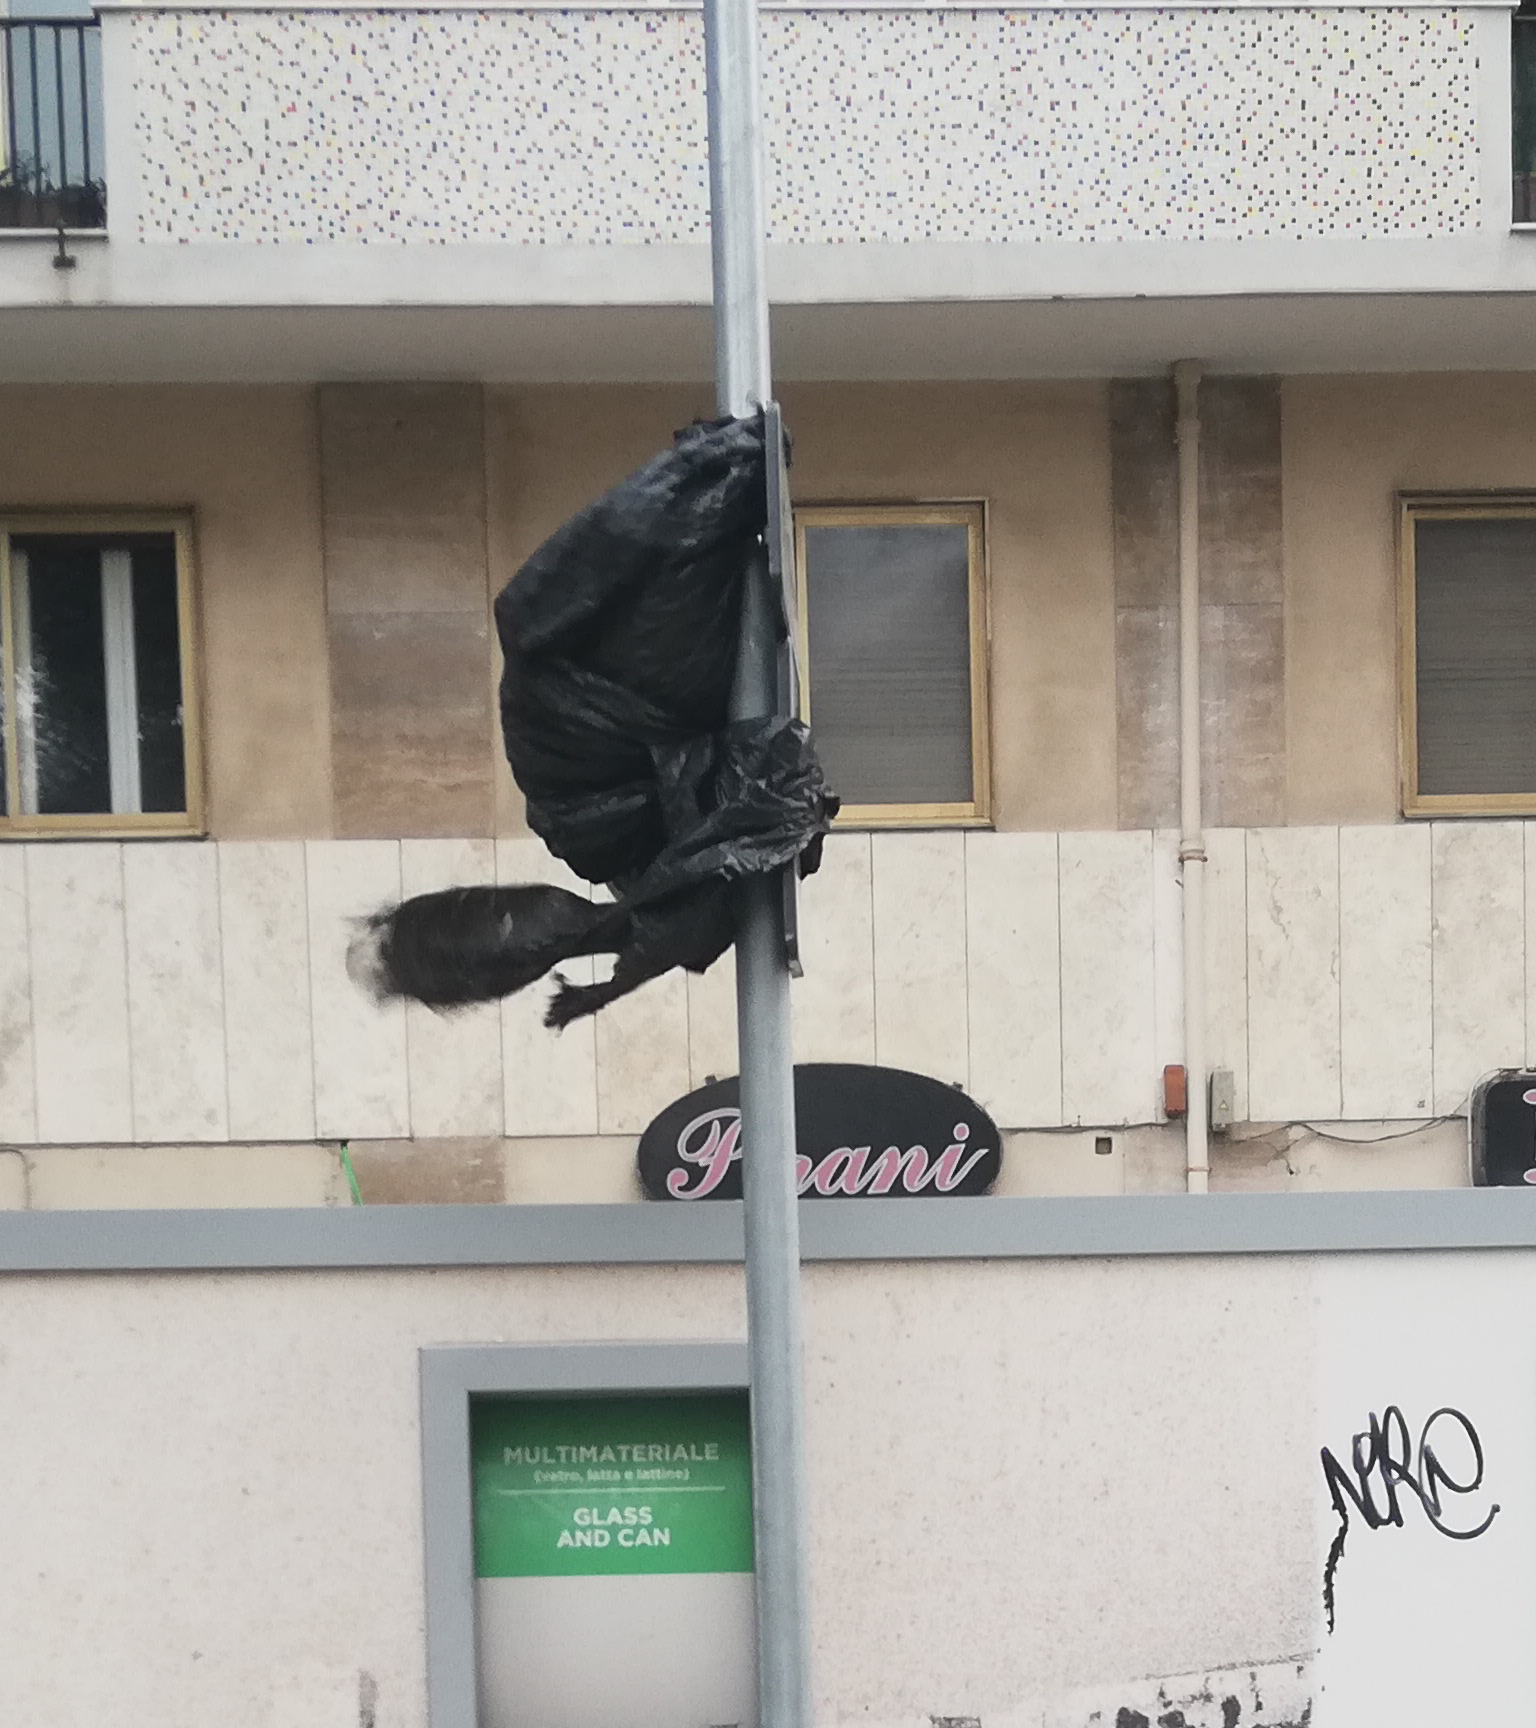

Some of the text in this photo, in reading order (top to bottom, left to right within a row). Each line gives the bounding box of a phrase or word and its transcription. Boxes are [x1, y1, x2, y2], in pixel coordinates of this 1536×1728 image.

[667, 1107, 989, 1199] Pani
[502, 1443, 720, 1465] MULTIMATERIALE
[573, 1506, 653, 1526] GLASS
[556, 1527, 671, 1548] AND CAN
